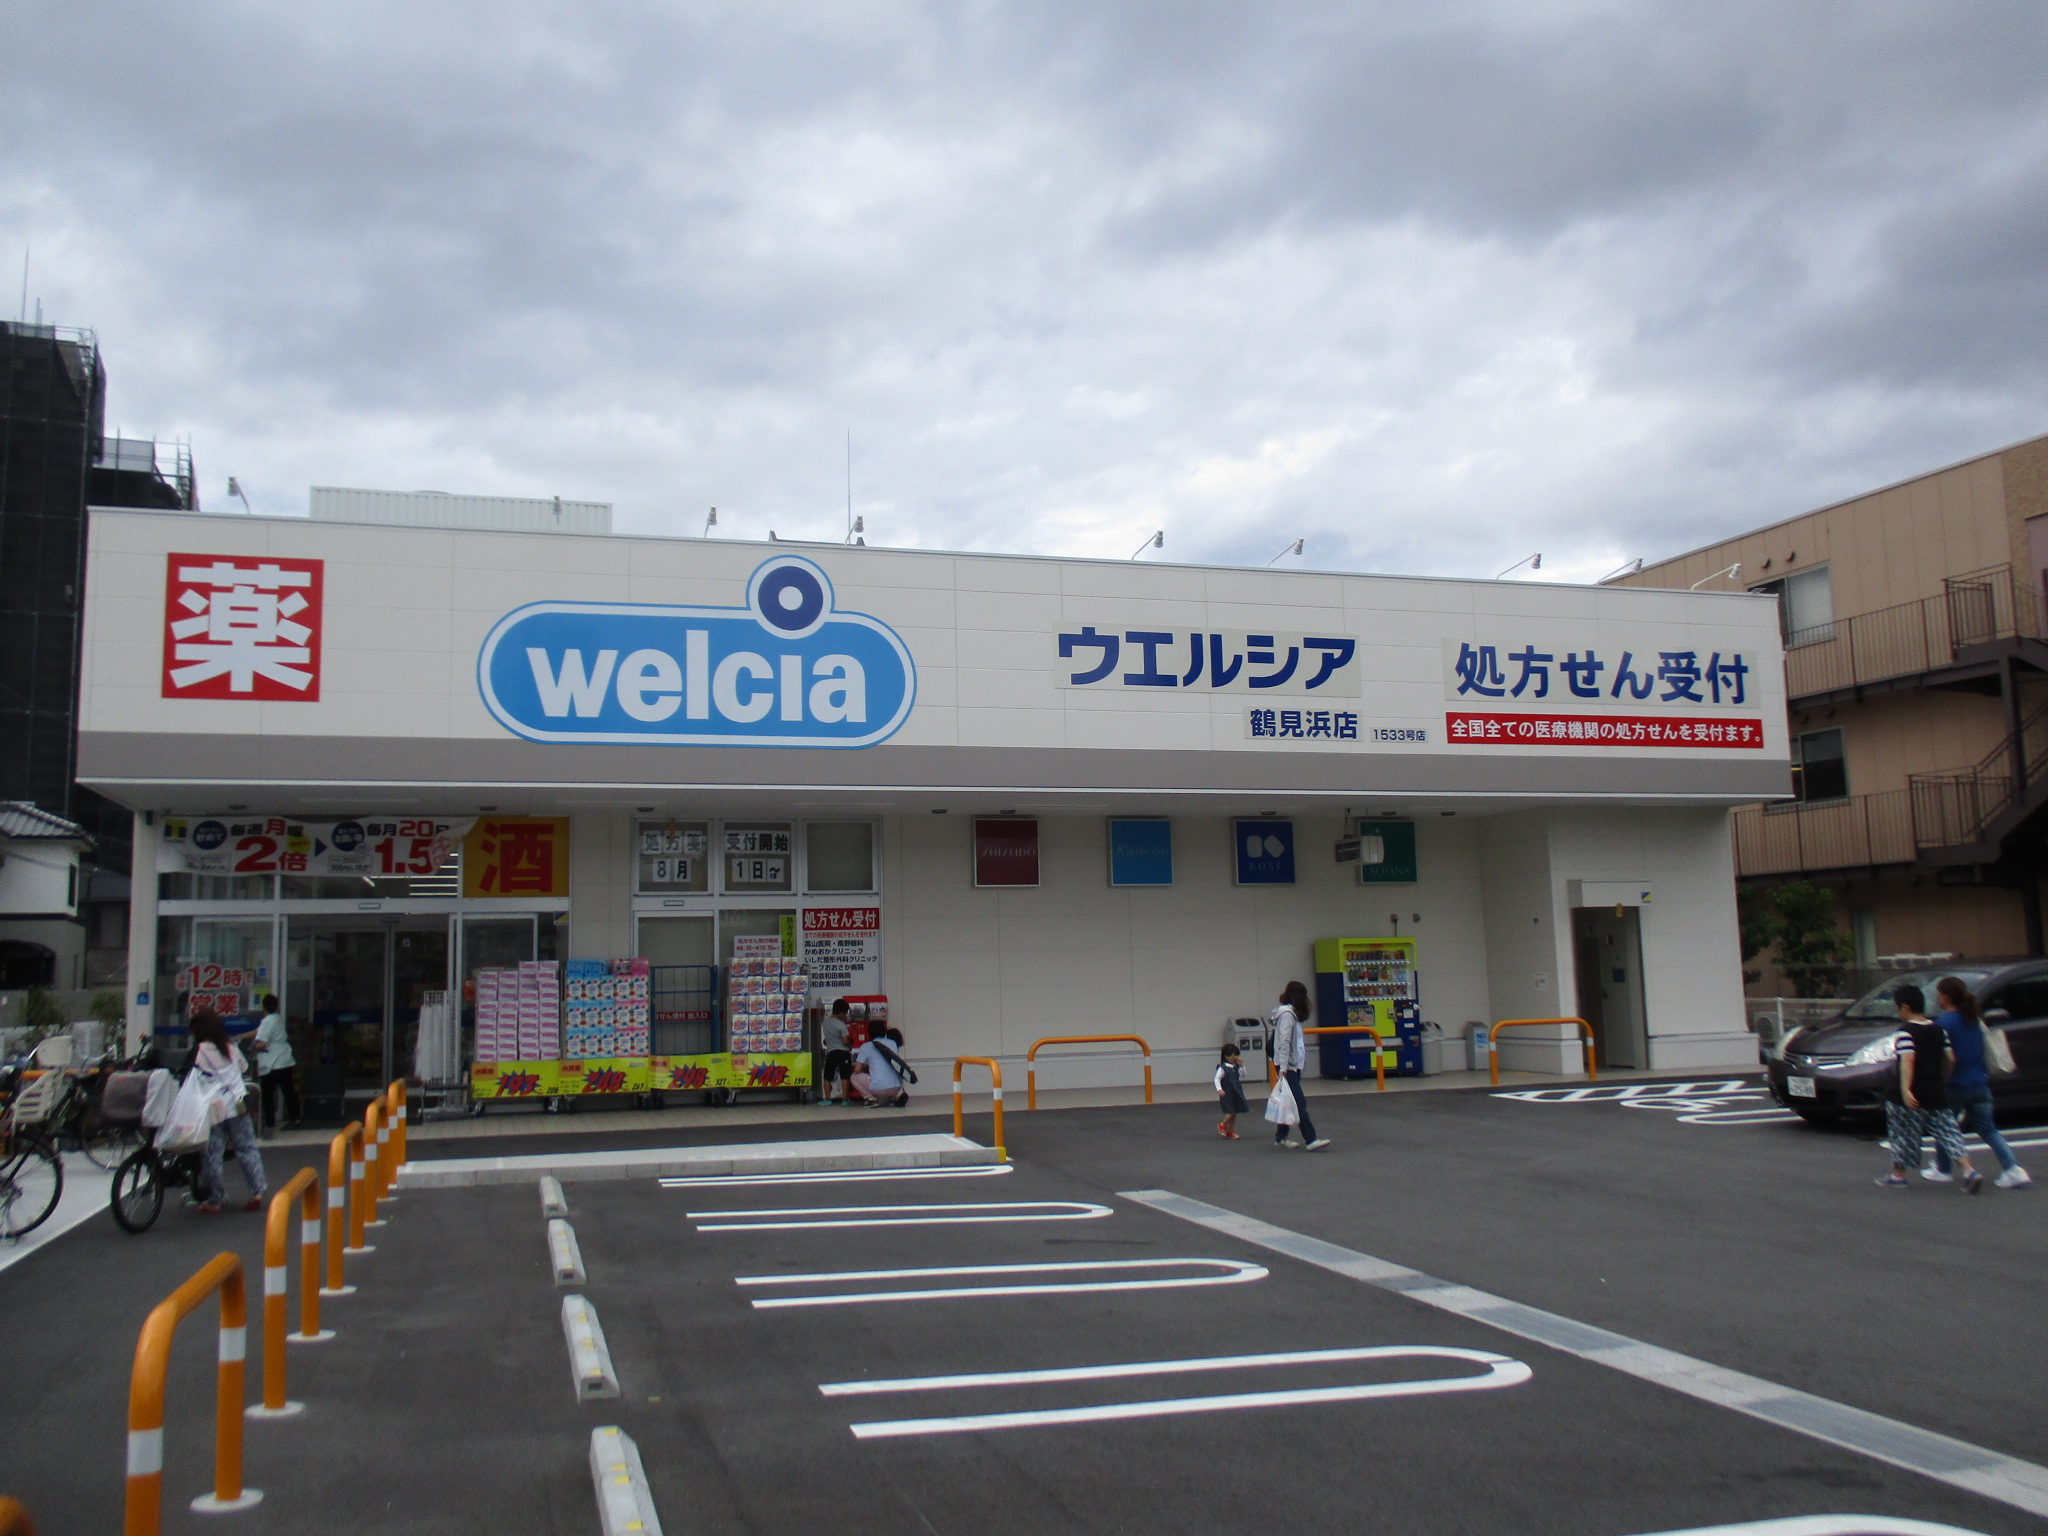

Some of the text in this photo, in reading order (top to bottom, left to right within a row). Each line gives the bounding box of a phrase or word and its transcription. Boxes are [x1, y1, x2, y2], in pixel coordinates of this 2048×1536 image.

[169, 561, 314, 692] 薬
[526, 566, 867, 723] welcia
[1058, 626, 1356, 689] ウエルシア
[1454, 642, 1749, 704] 処方せん受付
[1250, 709, 1358, 739] 鶴見浜店
[1451, 718, 1761, 743] 全国全ての医療機関の処方せんを受付ます。
[1373, 729, 1426, 741] 1533号店
[727, 832, 789, 852] 受付開始
[235, 836, 309, 872] 2倍
[479, 822, 553, 892] 酒
[657, 860, 688, 880] 8月
[1369, 866, 1410, 876] SOFINA
[803, 910, 877, 929] 処方せん受付
[810, 972, 851, 980] 和会和田病院
[811, 963, 864, 972] ープおおさか病院
[809, 980, 851, 988] 和会本田病院
[495, 1074, 541, 1097] 193
[582, 1071, 626, 1093] 248
[668, 1067, 708, 1088] 298
[747, 1066, 788, 1086] 148
